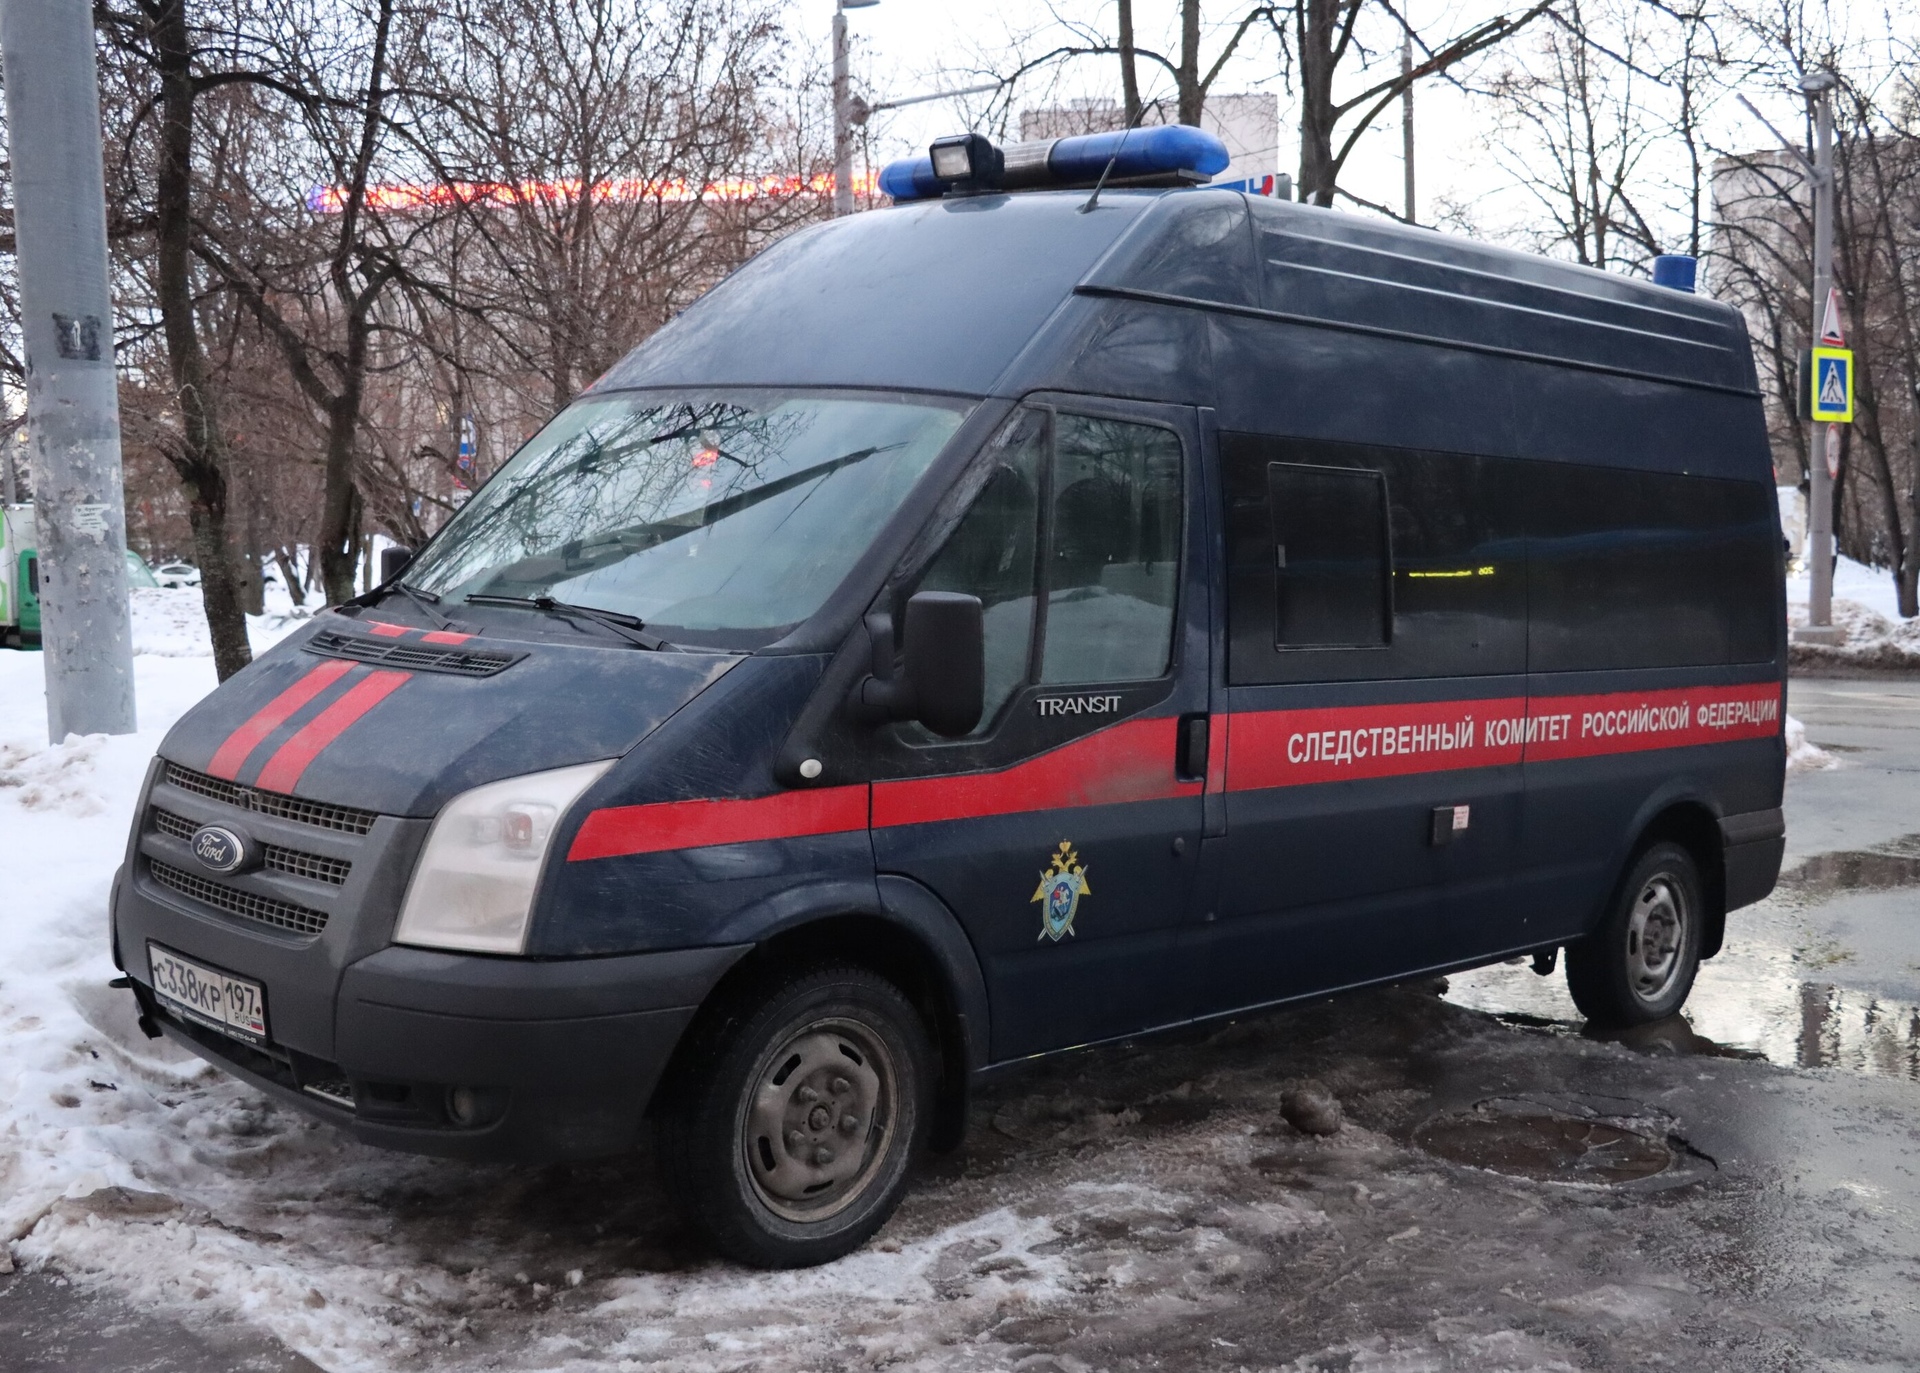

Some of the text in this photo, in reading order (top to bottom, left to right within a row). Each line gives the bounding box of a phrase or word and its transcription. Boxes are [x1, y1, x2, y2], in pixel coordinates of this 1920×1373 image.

[1037, 696, 1122, 716] TRANSIT
[1287, 699, 1778, 766] СЛЕДСТВЕННЫЙ КОМИТЕТ РОССИЙСКОЙ ФЕДЕРАЦИИ
[197, 833, 227, 861] Ford
[234, 1011, 251, 1026] RUS
